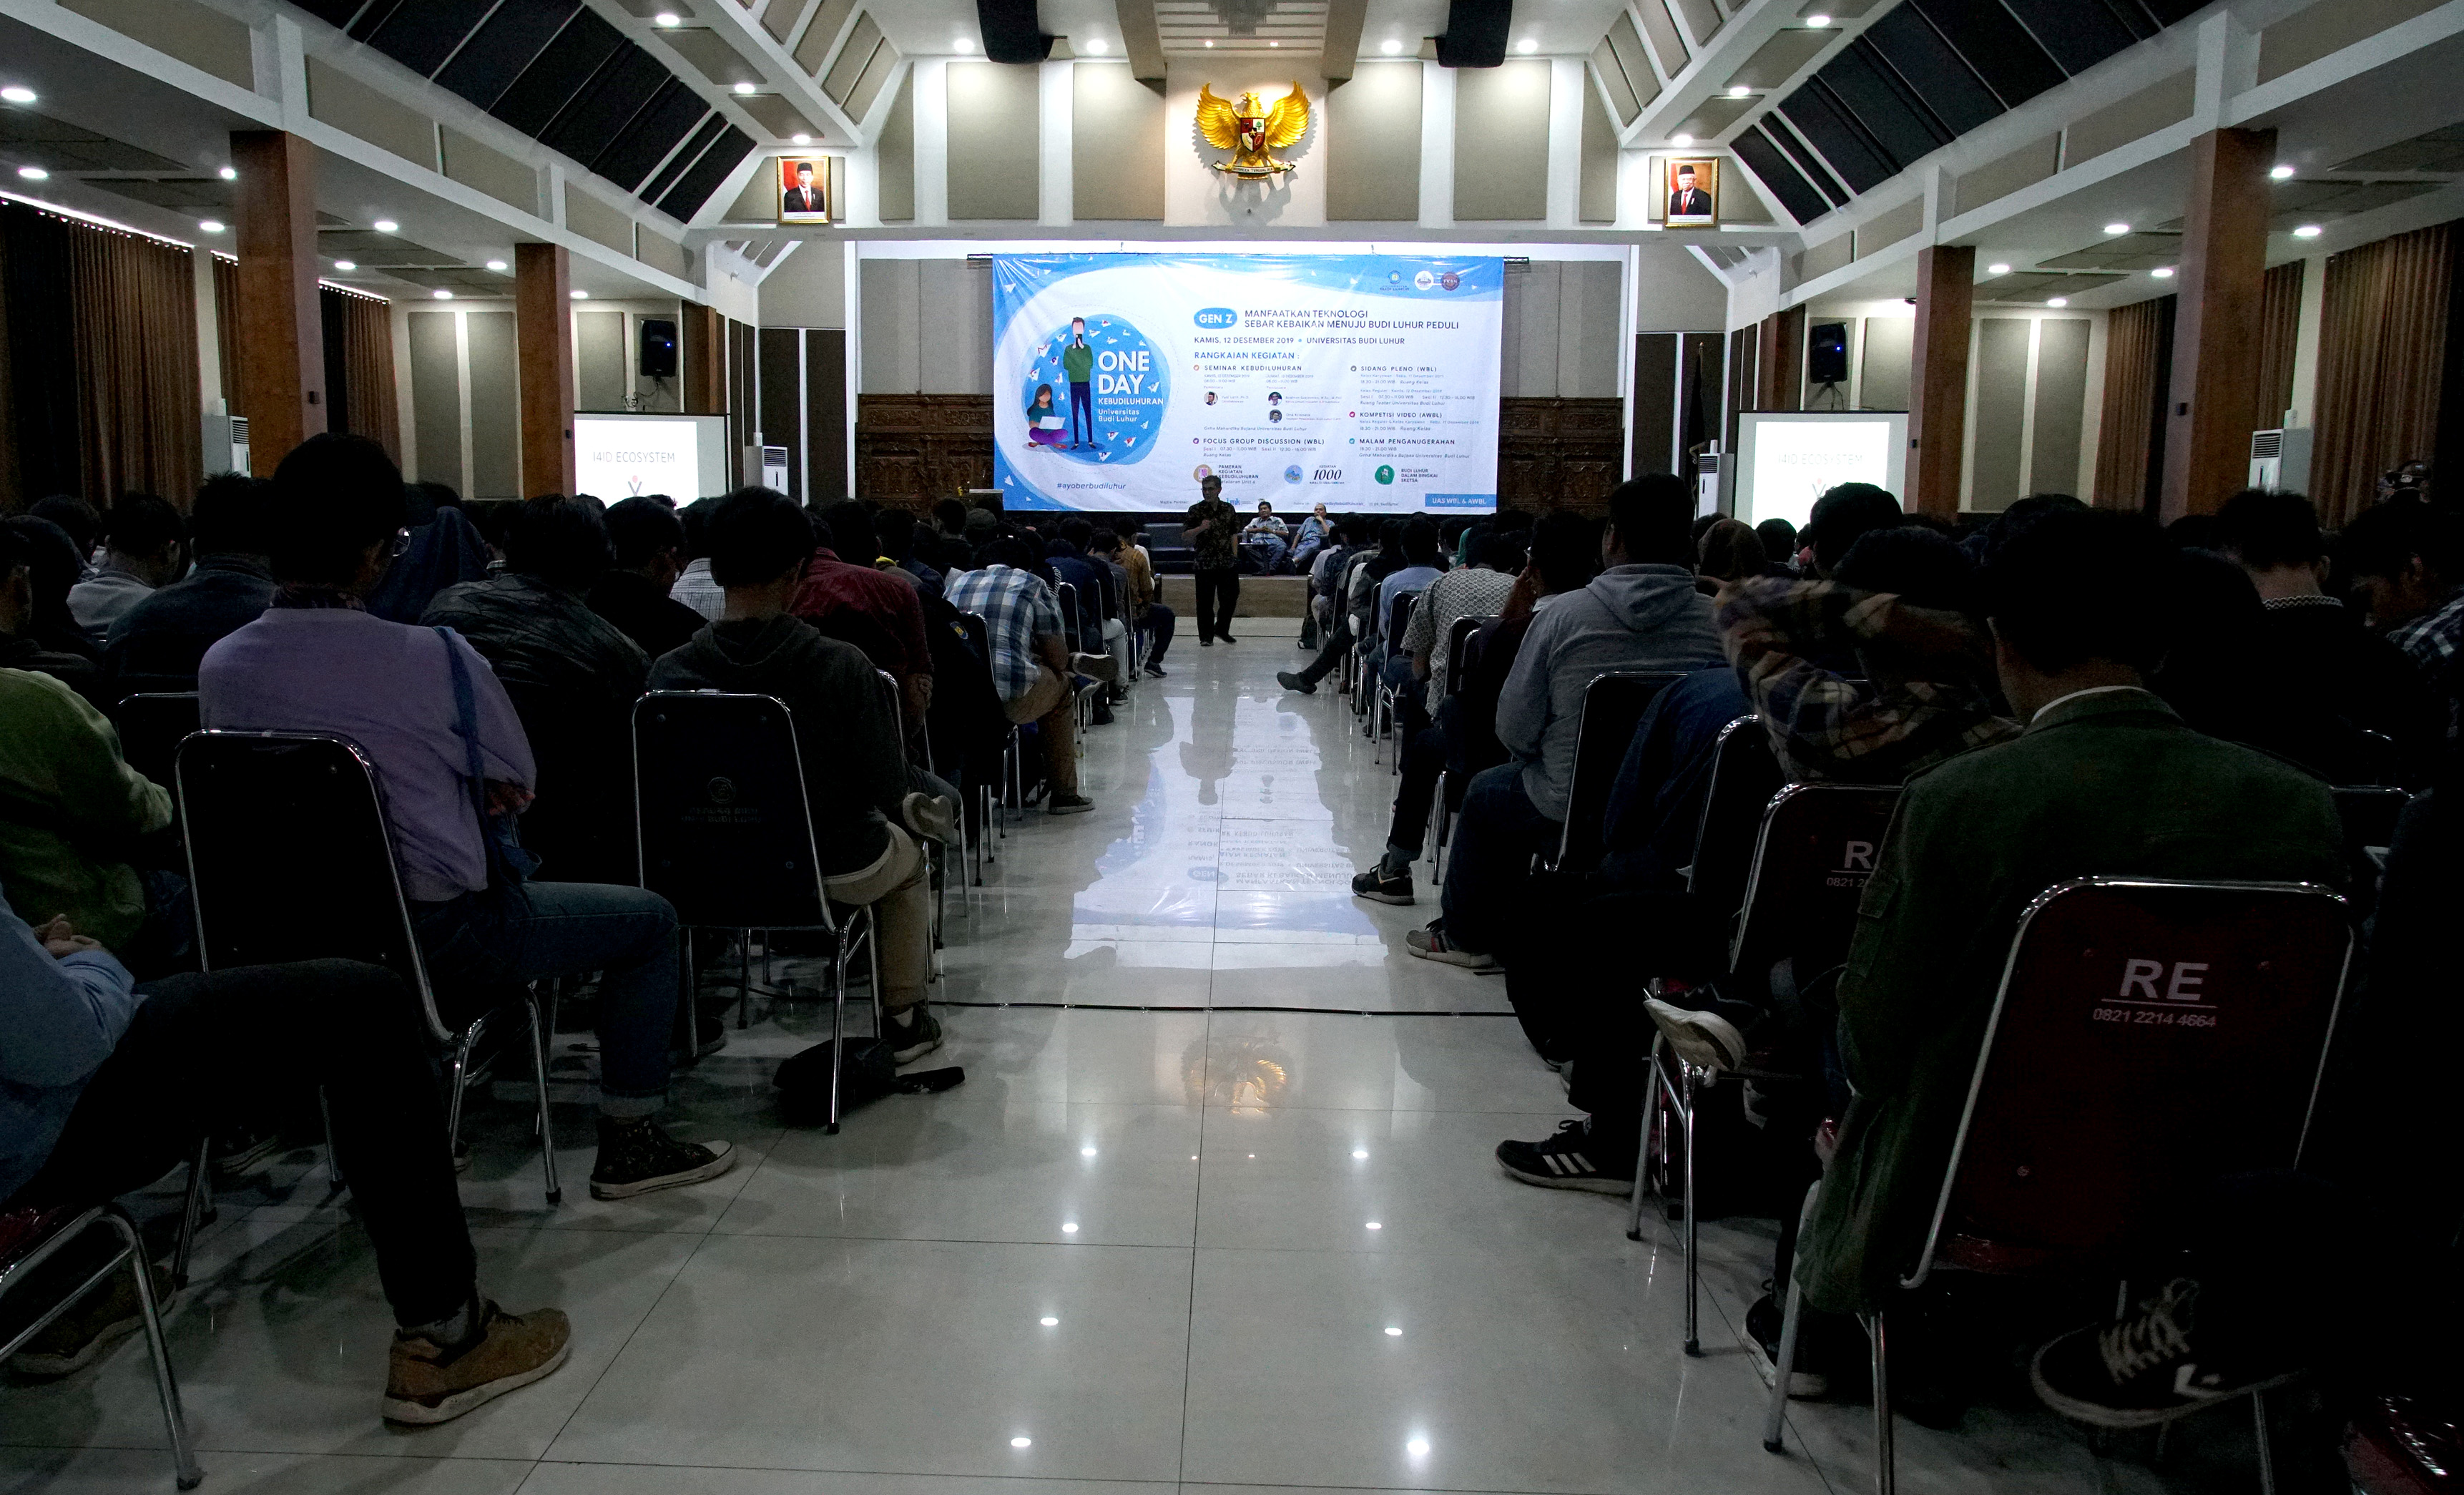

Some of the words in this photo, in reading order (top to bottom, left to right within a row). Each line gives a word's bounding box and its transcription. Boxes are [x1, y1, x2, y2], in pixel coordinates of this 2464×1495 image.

[1199, 313, 1223, 323] GEN
[1225, 313, 1232, 323] Z
[1098, 351, 1149, 372] ONE
[1098, 374, 1144, 395] DAY
[617, 452, 674, 463] ECOSYSTEM
[1802, 454, 1862, 464] ECOSYSTEM
[1314, 469, 1342, 480] 1000
[1827, 878, 1853, 887] 0821
[2120, 959, 2209, 1001] RE
[2093, 1009, 2130, 1022] 0821
[2134, 1011, 2173, 1024] 2214
[2176, 1014, 2217, 1026] 4664
